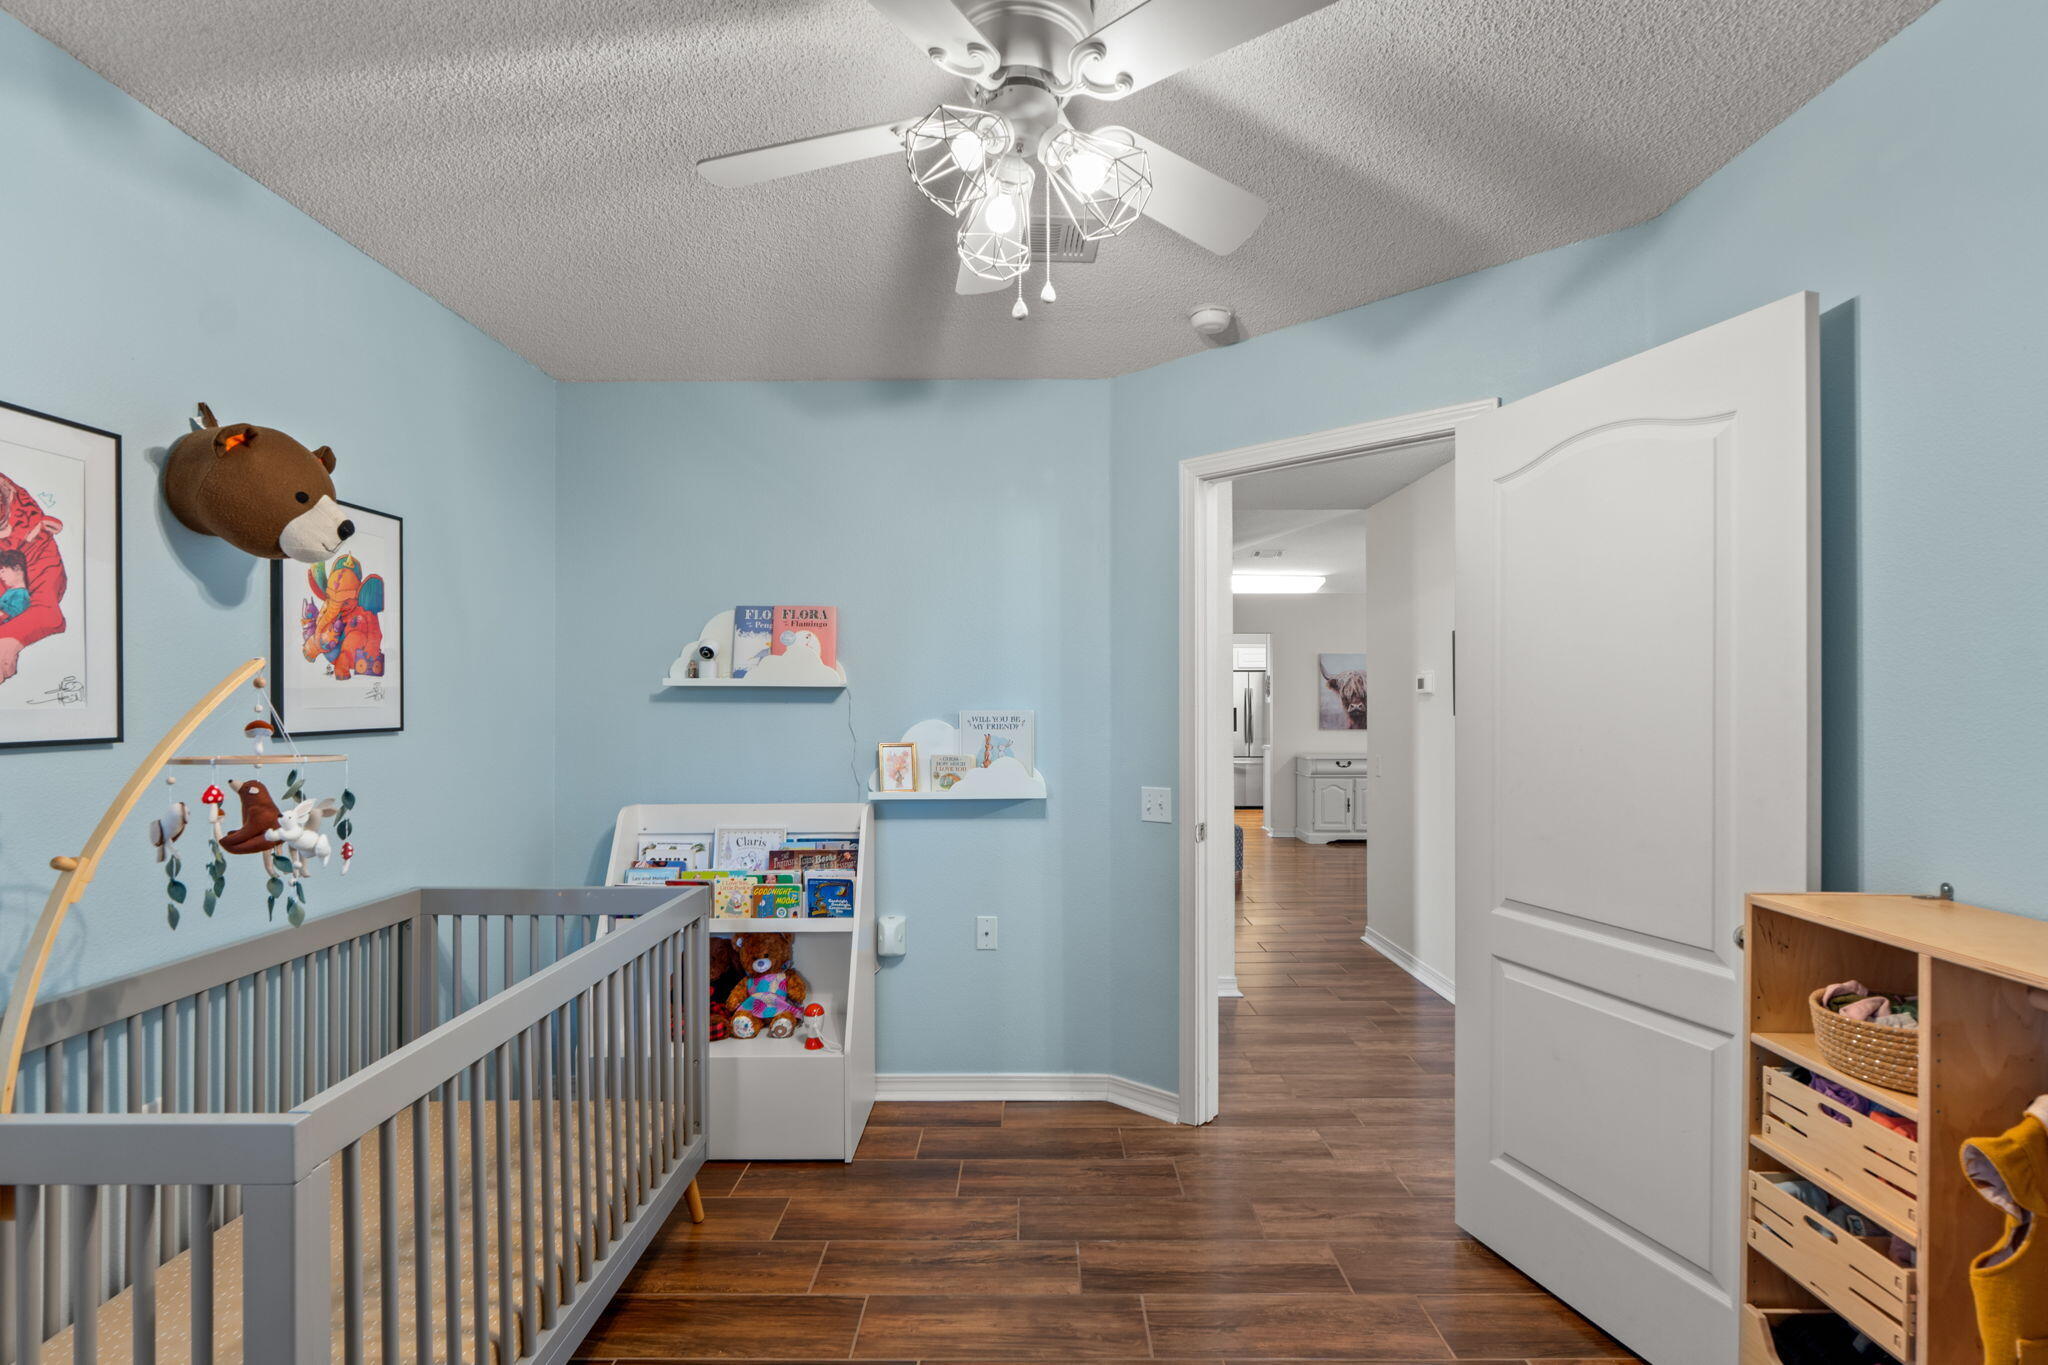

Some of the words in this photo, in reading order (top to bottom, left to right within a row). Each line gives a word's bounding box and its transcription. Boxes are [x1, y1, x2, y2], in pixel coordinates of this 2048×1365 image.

[745, 609, 773, 620] FLO
[782, 609, 828, 620] FLORA
[791, 620, 828, 628] Flamingo
[736, 836, 768, 847] Claris
[753, 888, 793, 896] GOODNIGHT
